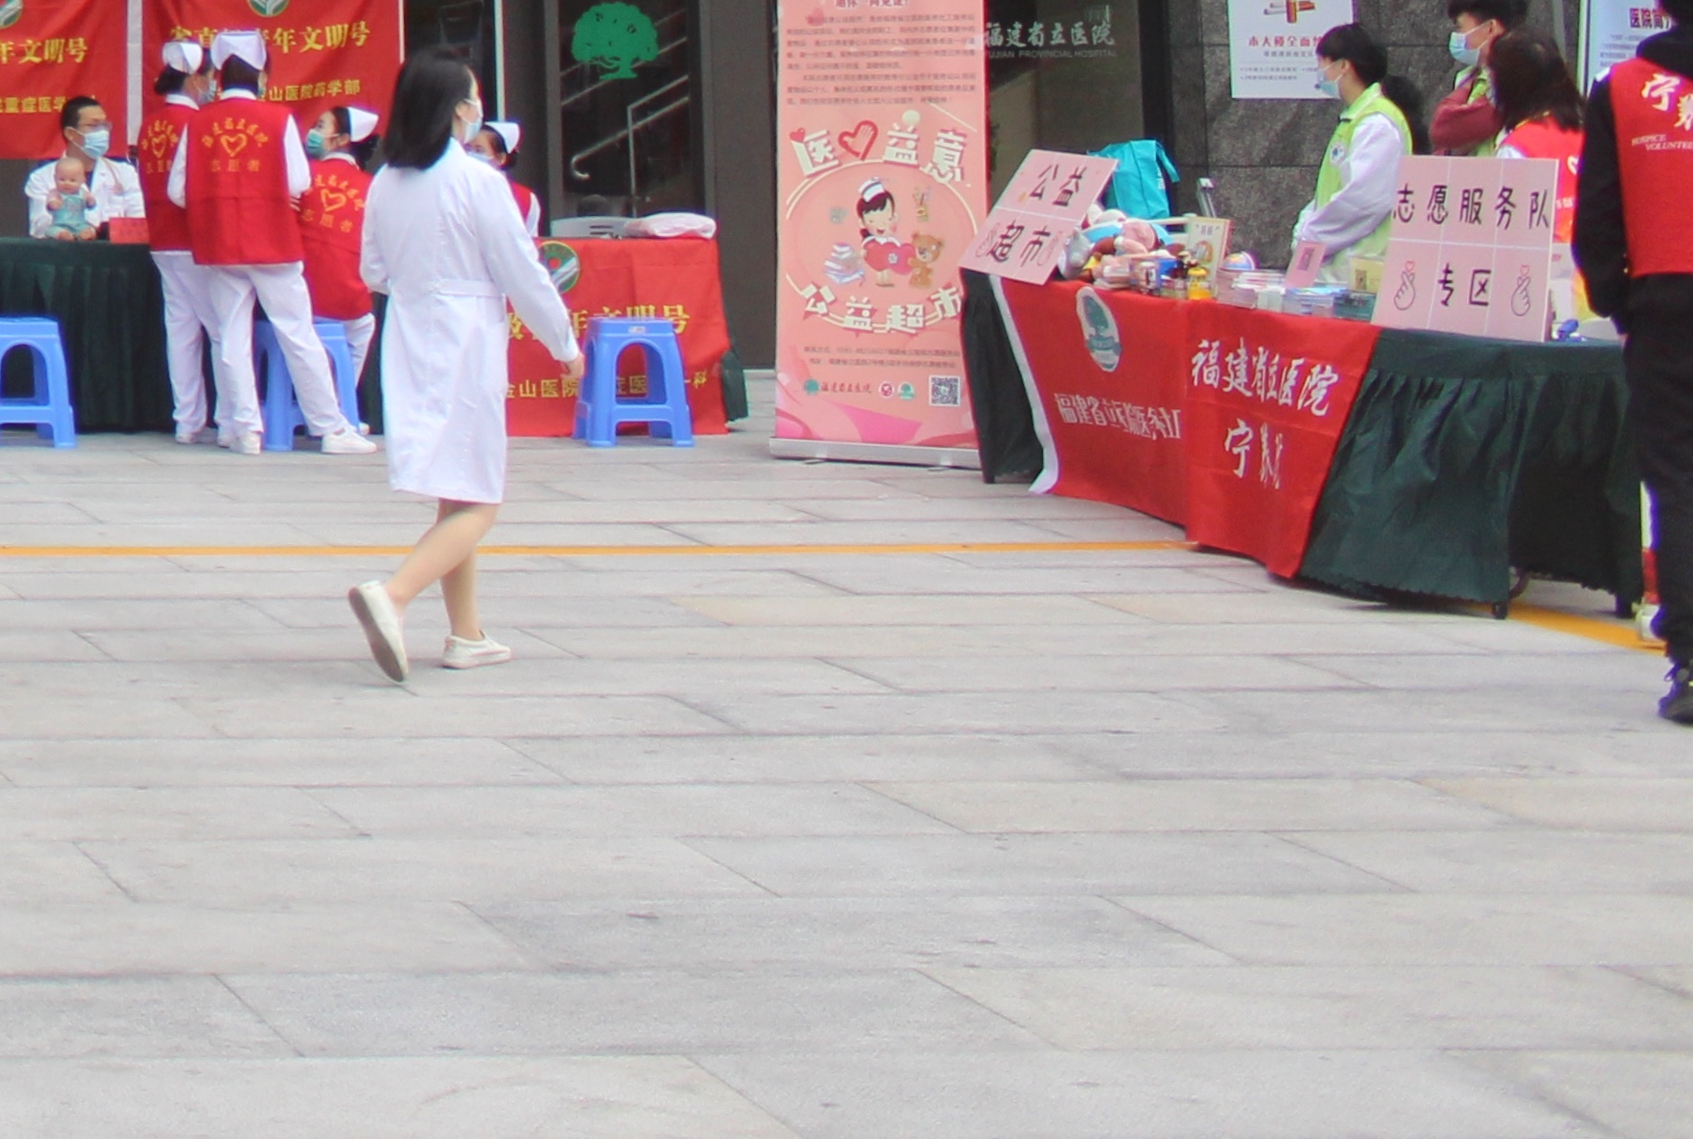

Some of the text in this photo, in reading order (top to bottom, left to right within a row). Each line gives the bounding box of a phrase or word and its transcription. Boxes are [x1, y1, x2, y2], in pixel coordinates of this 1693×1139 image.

[1392, 183, 1550, 230] 志愿服务队
[991, 223, 1045, 269] 超市
[801, 282, 962, 334] 公益超市
[1437, 266, 1492, 308] 专区
